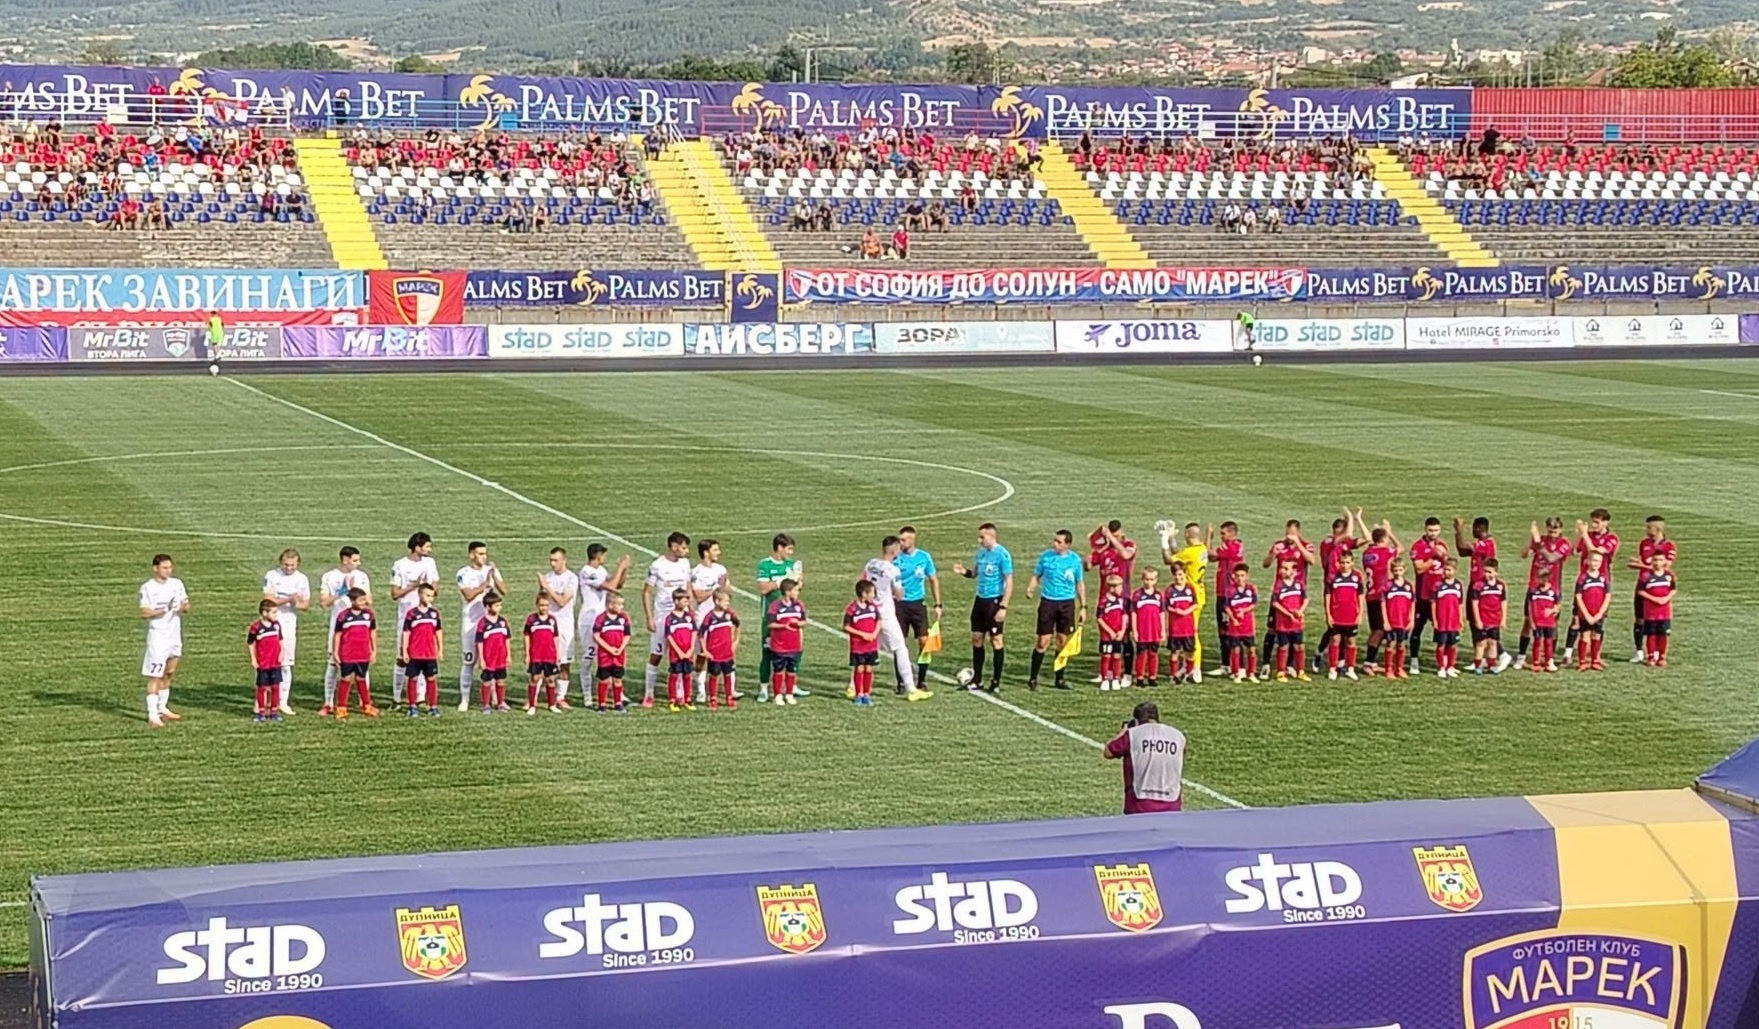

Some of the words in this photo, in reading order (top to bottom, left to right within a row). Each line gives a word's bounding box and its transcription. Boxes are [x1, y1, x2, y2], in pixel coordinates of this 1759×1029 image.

[63, 74, 134, 113] BET
[232, 79, 349, 116] PAMS
[358, 81, 425, 119] BET
[520, 86, 631, 122] PALMS
[637, 89, 700, 126] BET
[788, 91, 894, 128] PALMS
[902, 92, 960, 128] BET
[1153, 95, 1212, 131] BET
[1293, 97, 1391, 132] PALMS
[1396, 97, 1454, 132] BET
[123, 274, 357, 313] ЗАВИНАГИ
[463, 280, 523, 299] ALMS
[526, 276, 569, 300] BET
[609, 275, 680, 299] PALMS
[684, 275, 723, 299] BET
[816, 273, 850, 296] ОТ
[855, 273, 944, 298] СОФИЯ
[950, 273, 986, 299] ДО
[992, 272, 1076, 297] СОЛУН
[1103, 271, 1171, 295] САМО
[1307, 273, 1369, 296] PALMS
[1373, 272, 1409, 296] BET
[1445, 272, 1507, 295] PALMS
[1510, 271, 1546, 294] BET
[1583, 271, 1649, 295] PALMS
[1652, 271, 1690, 294] BET
[83, 329, 150, 348] MrBit
[343, 327, 429, 352] MrBit
[1419, 326, 1450, 338] Hotel
[1455, 326, 1501, 338] MIRAGE
[1504, 326, 1560, 337] Primorsko
[207, 349, 238, 358] ВОРА
[1142, 740, 1178, 755] PHOTO
[1283, 909, 1323, 923] Since
[1326, 905, 1366, 919] 1990
[999, 925, 1040, 940] 1990
[602, 953, 647, 968] Since
[650, 948, 695, 964] 1990
[1512, 938, 1597, 961] ФУТБОЛЕН
[1599, 940, 1642, 957] КЛУБ
[224, 978, 272, 995] Since
[275, 973, 323, 989] 1990
[1486, 955, 1663, 1015] МАРЕК
